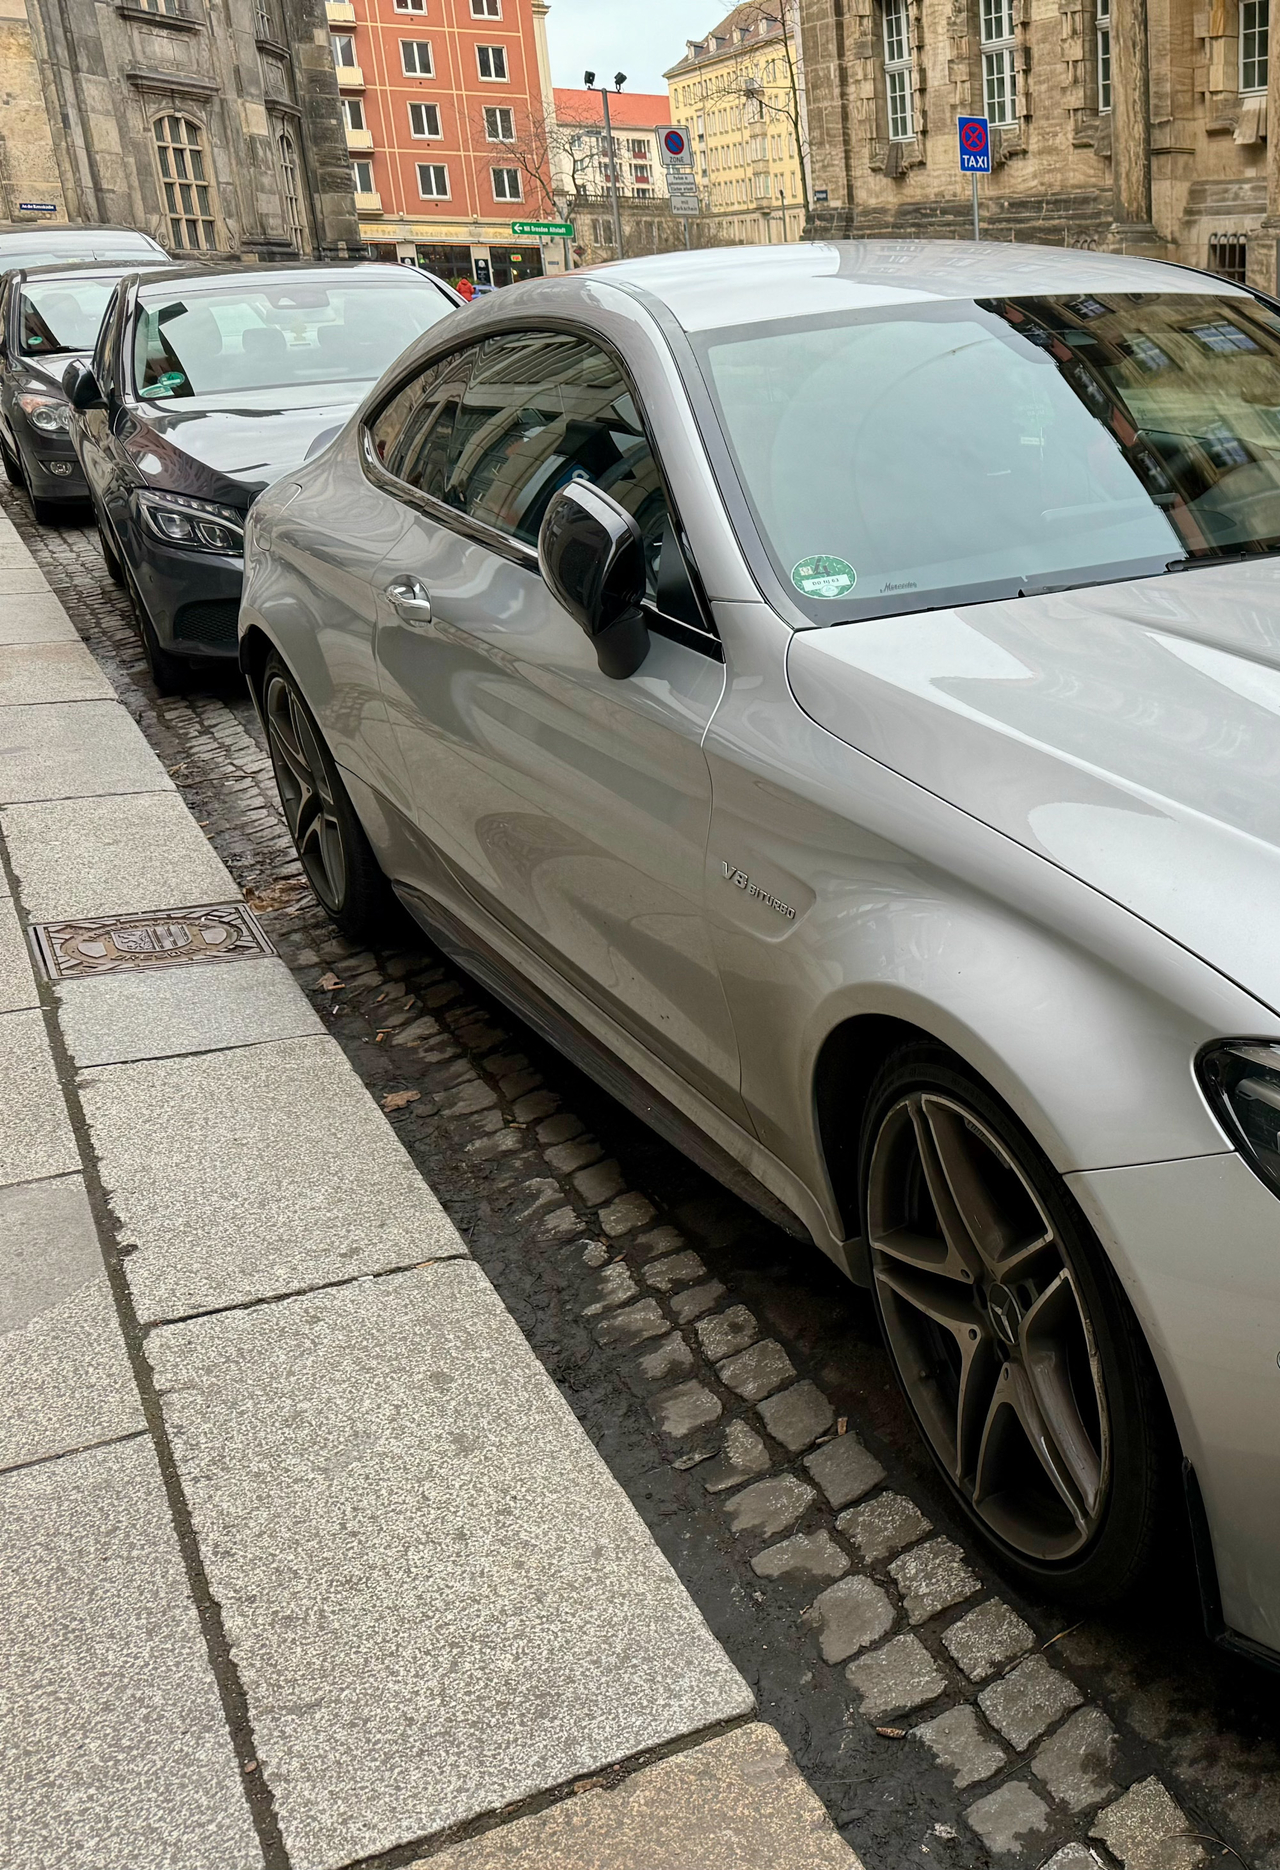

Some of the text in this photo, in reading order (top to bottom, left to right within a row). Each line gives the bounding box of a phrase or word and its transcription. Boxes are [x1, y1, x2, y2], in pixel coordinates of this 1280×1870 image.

[962, 155, 988, 168] TAXI
[721, 860, 797, 920] V8 BITURBO
